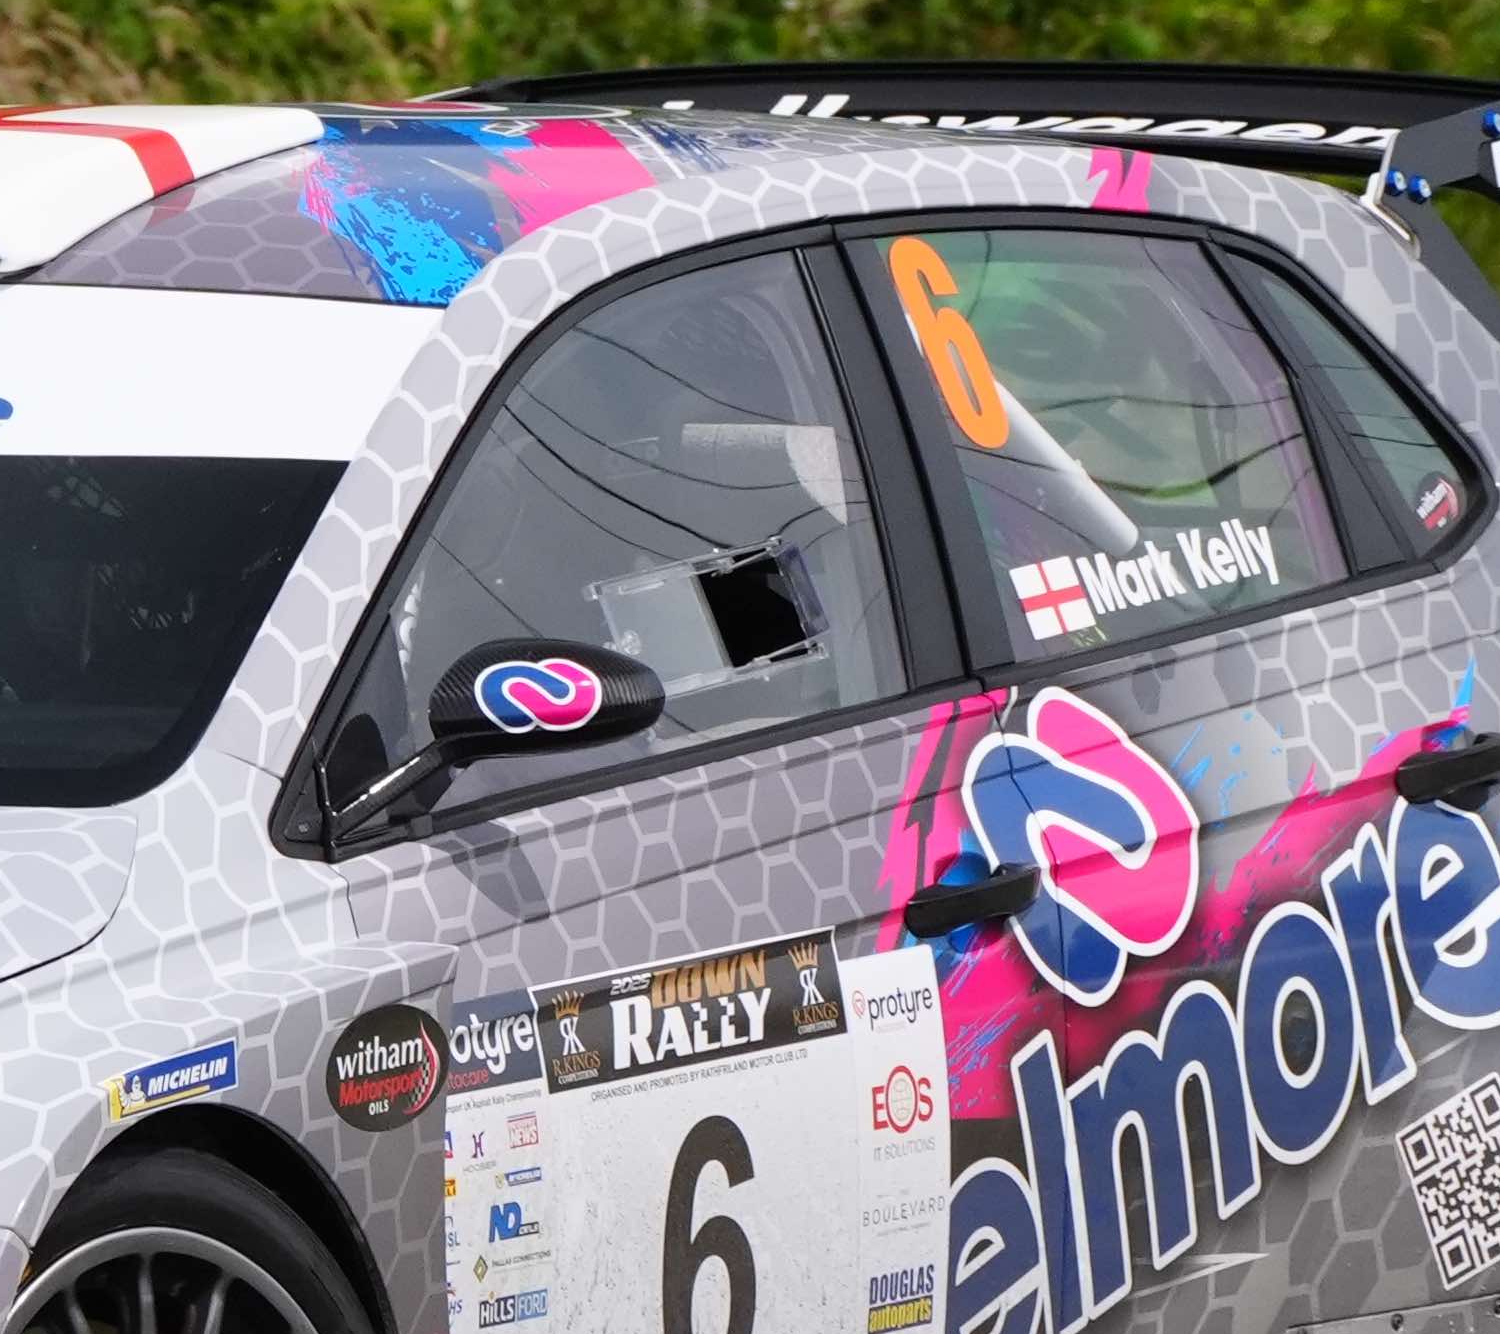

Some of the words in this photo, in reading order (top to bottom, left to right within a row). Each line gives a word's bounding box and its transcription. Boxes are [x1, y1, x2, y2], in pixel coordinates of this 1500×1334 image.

[889, 234, 1010, 451] 6
[1076, 540, 1187, 616] Mark
[1176, 517, 1281, 591] Kelly
[609, 972, 652, 996] 2025
[650, 949, 768, 1009] DOWN
[609, 987, 772, 1071] RALLY
[867, 987, 933, 1032] protyre
[336, 1035, 424, 1080] witham
[450, 1012, 535, 1074] otyre
[147, 1057, 228, 1097] MICHELIN
[339, 1066, 424, 1108] Motorsport
[591, 1084, 632, 1103] ORGANISED
[633, 1080, 648, 1095] AND
[649, 1073, 690, 1091] PROMOTED
[689, 1070, 700, 1083] BY
[750, 1054, 774, 1069] MOTOR
[775, 1052, 794, 1065] CLUB
[795, 1048, 808, 1060] LTD
[368, 1099, 390, 1115] OILS
[872, 1064, 934, 1134] EOS
[873, 1146, 883, 1162] IT
[884, 1136, 936, 1161] SOLUTIONS
[862, 1195, 945, 1227] BOULEVARD
[518, 1291, 548, 1317] FORD
[869, 1264, 935, 1304] DOUGLAS
[869, 1296, 933, 1334] autoparts
